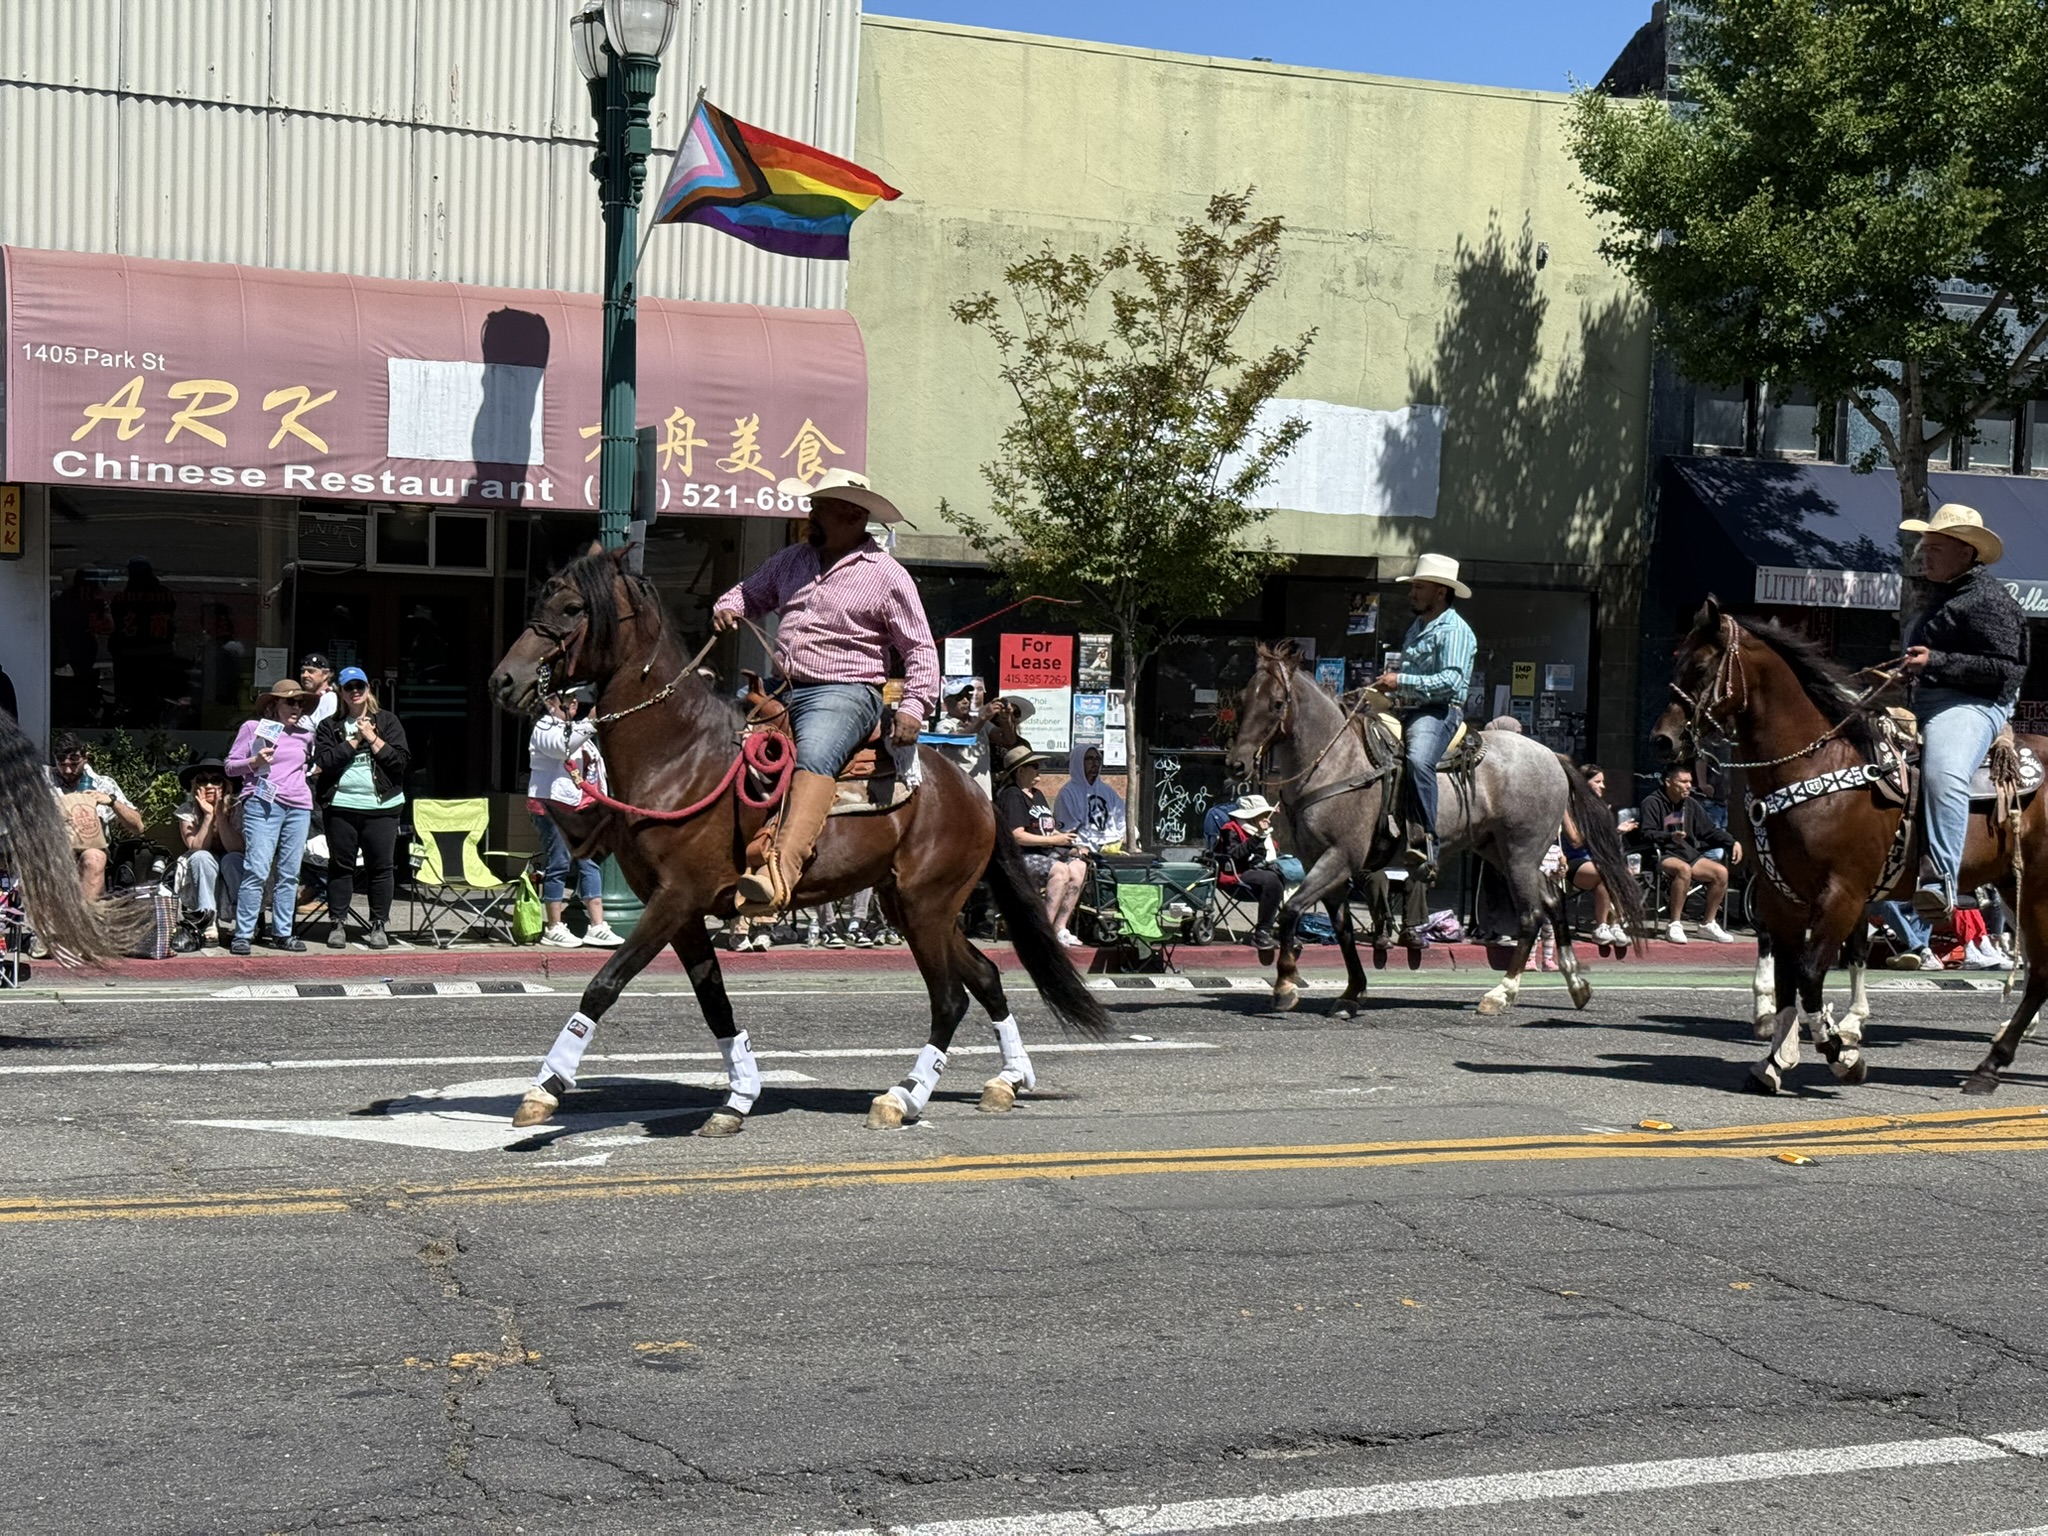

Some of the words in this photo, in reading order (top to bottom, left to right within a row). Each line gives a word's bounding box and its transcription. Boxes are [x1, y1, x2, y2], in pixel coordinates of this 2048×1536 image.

[22, 343, 77, 364] 1405
[84, 348, 136, 369] Park
[142, 353, 165, 371] St
[71, 375, 338, 454] ARK
[52, 450, 267, 487] Chinese
[284, 464, 554, 501] Restaurant
[682, 483, 813, 513] 521-686
[4, 493, 17, 545] ARK
[1763, 573, 1818, 602] LITTLE
[1022, 638, 1052, 652] For
[1011, 655, 1062, 670] Lease
[1515, 665, 1532, 673] IMP
[1004, 674, 1068, 685] 415.3957262
